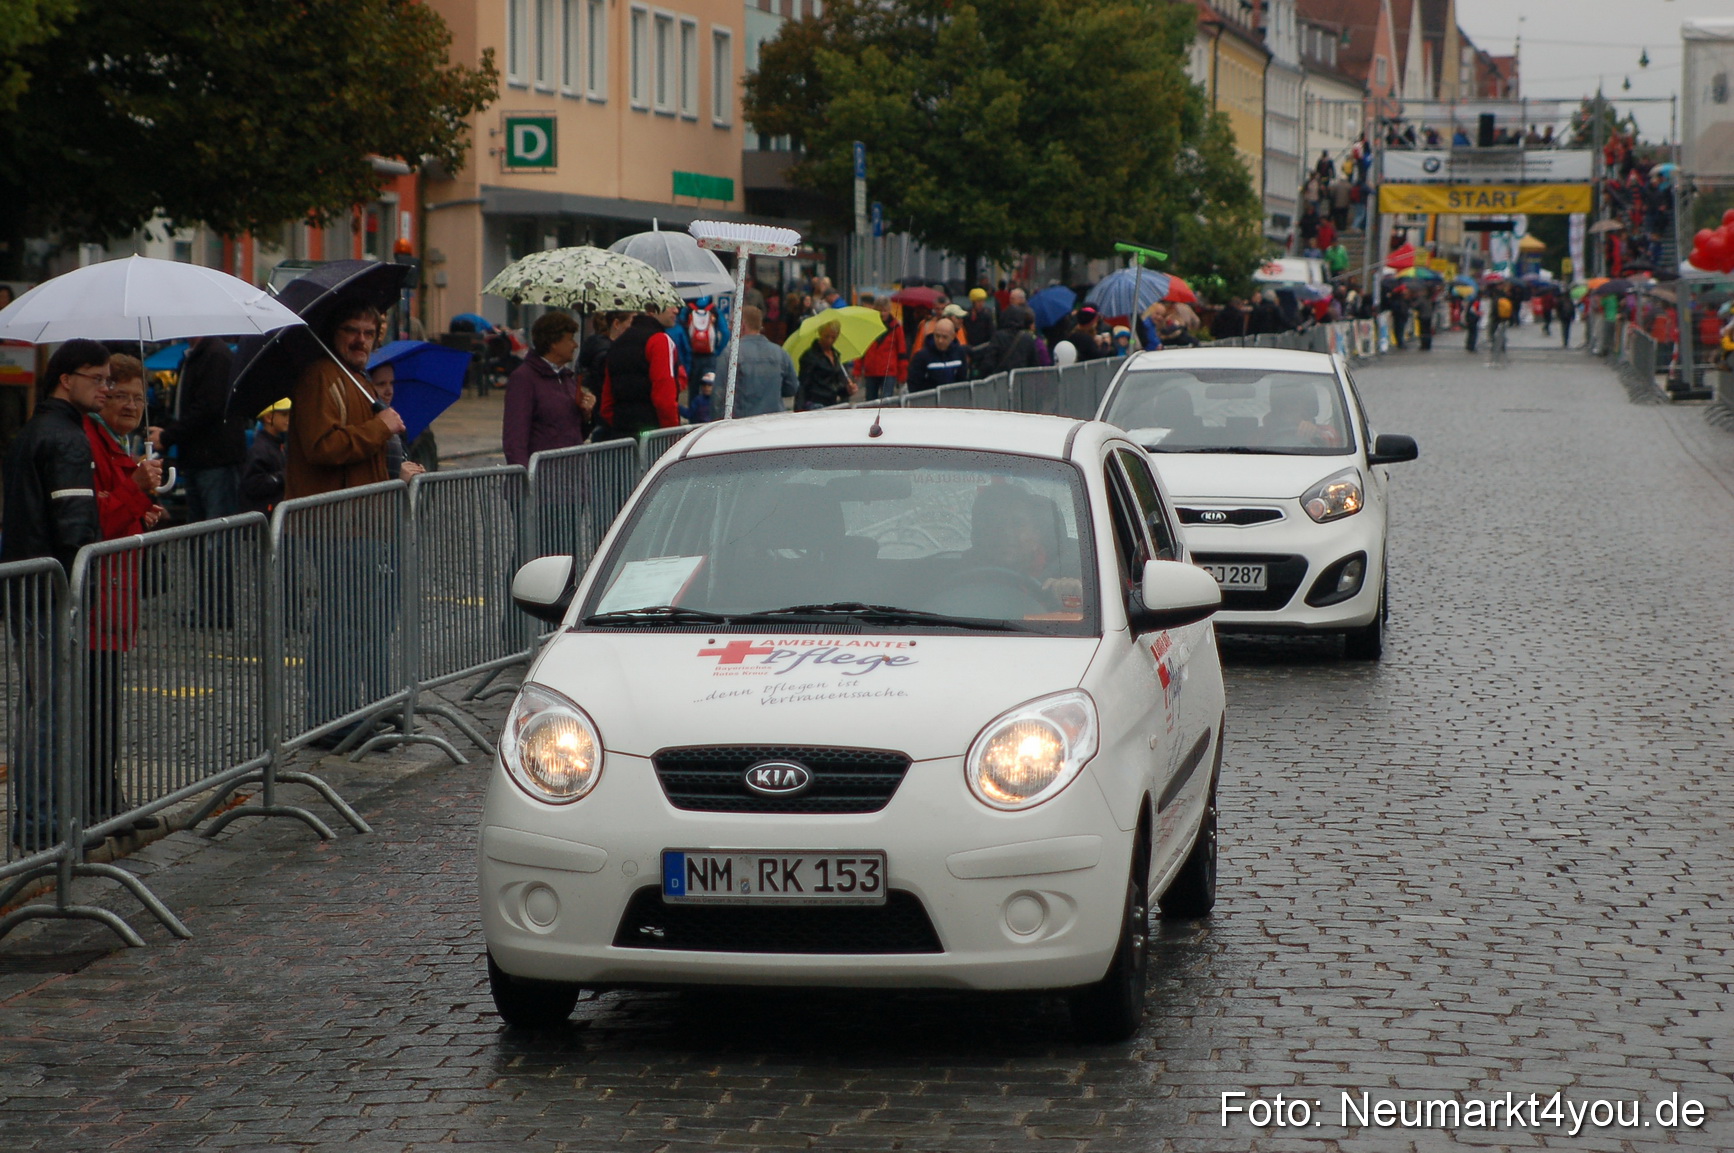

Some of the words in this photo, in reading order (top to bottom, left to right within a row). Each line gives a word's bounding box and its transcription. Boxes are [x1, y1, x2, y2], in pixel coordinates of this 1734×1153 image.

[513, 124, 548, 160] D
[1447, 190, 1521, 209] START
[1204, 512, 1223, 520] KIA
[1229, 566, 1262, 584] 287
[760, 639, 908, 649] AMBULANTE
[760, 646, 919, 676] Pflege
[838, 679, 860, 688] ist
[756, 769, 798, 786] KIA
[671, 878, 680, 889] D
[686, 857, 733, 892] NM
[758, 858, 805, 893] RK
[813, 858, 880, 893] 153
